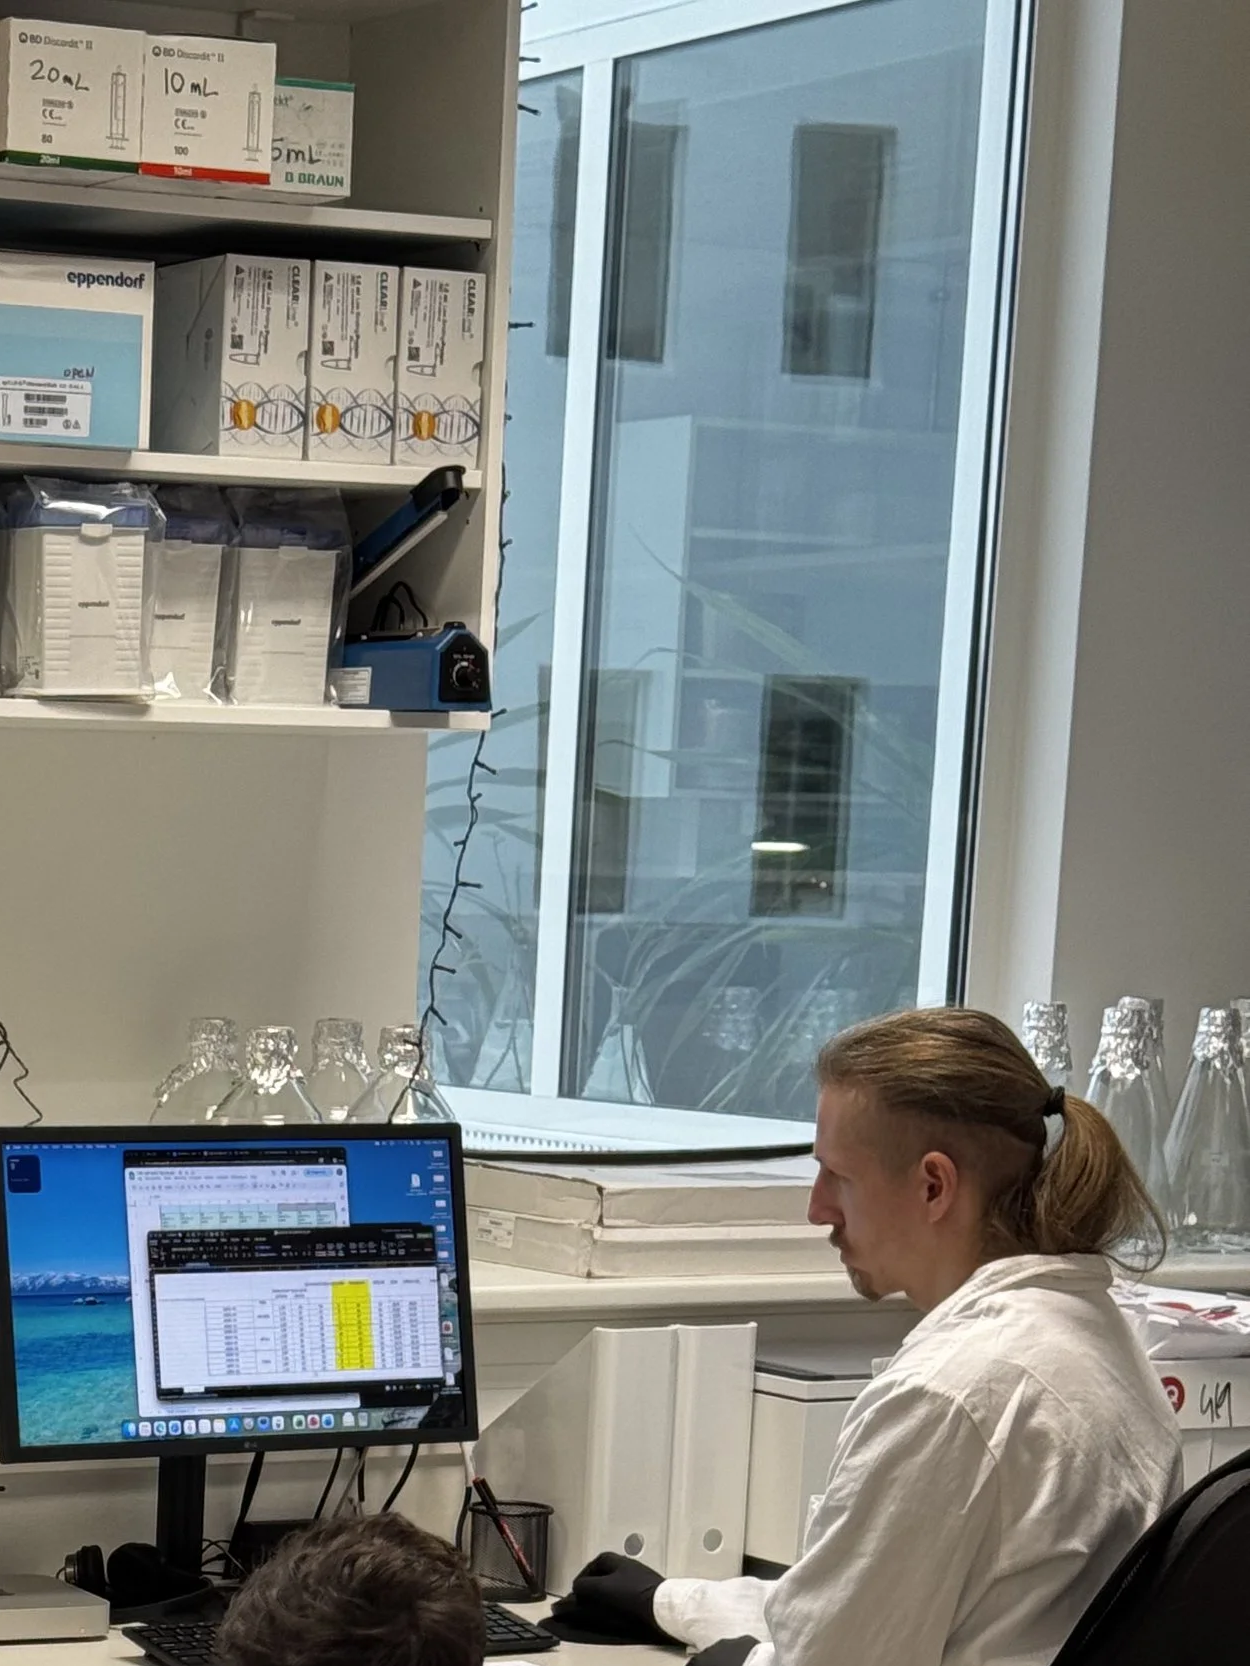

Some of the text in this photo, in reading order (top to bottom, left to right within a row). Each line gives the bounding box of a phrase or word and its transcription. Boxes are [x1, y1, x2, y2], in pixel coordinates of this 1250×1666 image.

[174, 146, 189, 156] 100
[298, 173, 344, 187] BRAUN
[66, 270, 146, 289] eppendorf
[63, 366, 95, 379] OPEN
